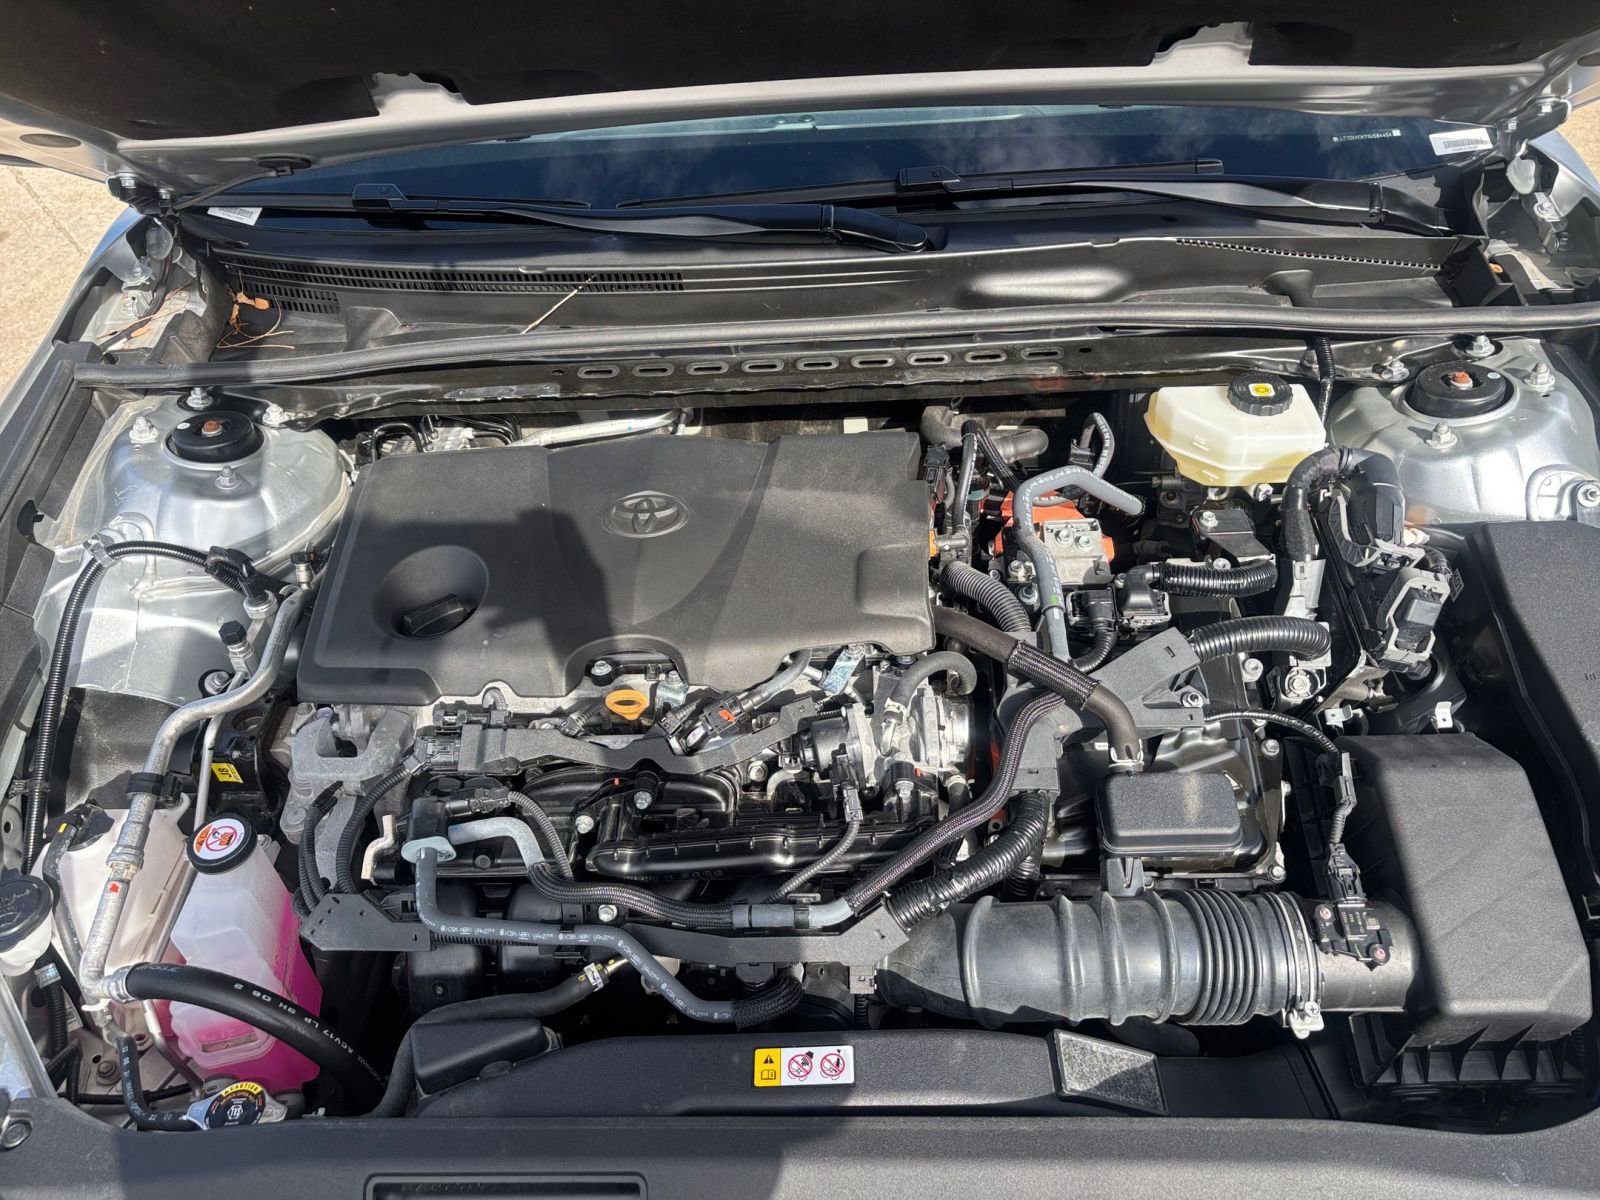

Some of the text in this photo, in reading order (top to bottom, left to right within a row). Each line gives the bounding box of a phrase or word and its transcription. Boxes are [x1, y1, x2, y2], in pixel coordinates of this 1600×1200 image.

[304, 1016, 319, 1028] LP
[323, 1029, 354, 1054] ACV17
[230, 1082, 259, 1092] CAUTION
